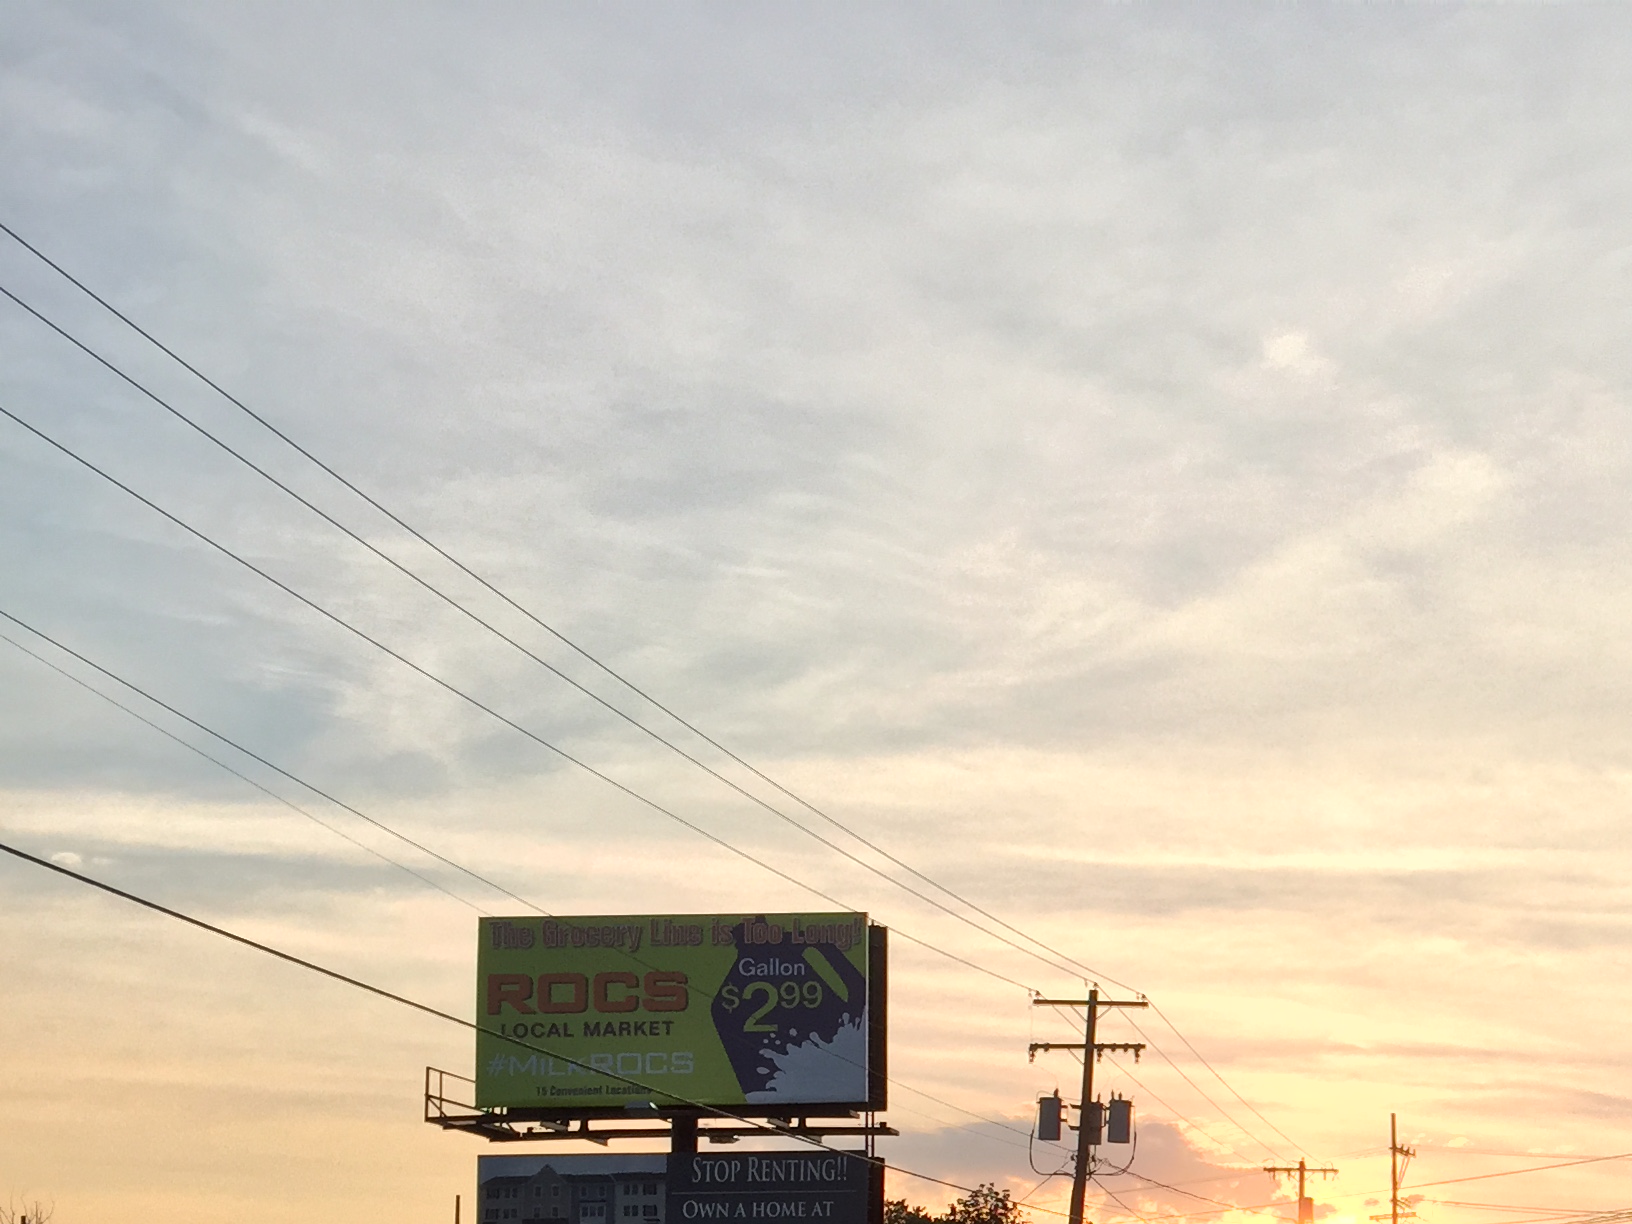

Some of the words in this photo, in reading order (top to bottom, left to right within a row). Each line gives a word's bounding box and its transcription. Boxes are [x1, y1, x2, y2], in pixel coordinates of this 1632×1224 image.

[489, 921, 534, 949] The
[542, 919, 643, 952] Grocery
[649, 918, 703, 948] Line
[711, 918, 734, 945] is
[741, 917, 783, 944] Too
[738, 957, 806, 977] Gallon
[487, 971, 689, 1016] ROCS
[500, 1022, 574, 1039] LOCAL
[583, 1021, 675, 1038] MARKET
[550, 1085, 603, 1096] Convenient
[691, 1157, 741, 1183] STOP
[682, 1200, 729, 1219] OWN
[734, 1202, 747, 1218] A
[752, 1201, 807, 1218] HOME
[811, 1201, 834, 1217] AT
